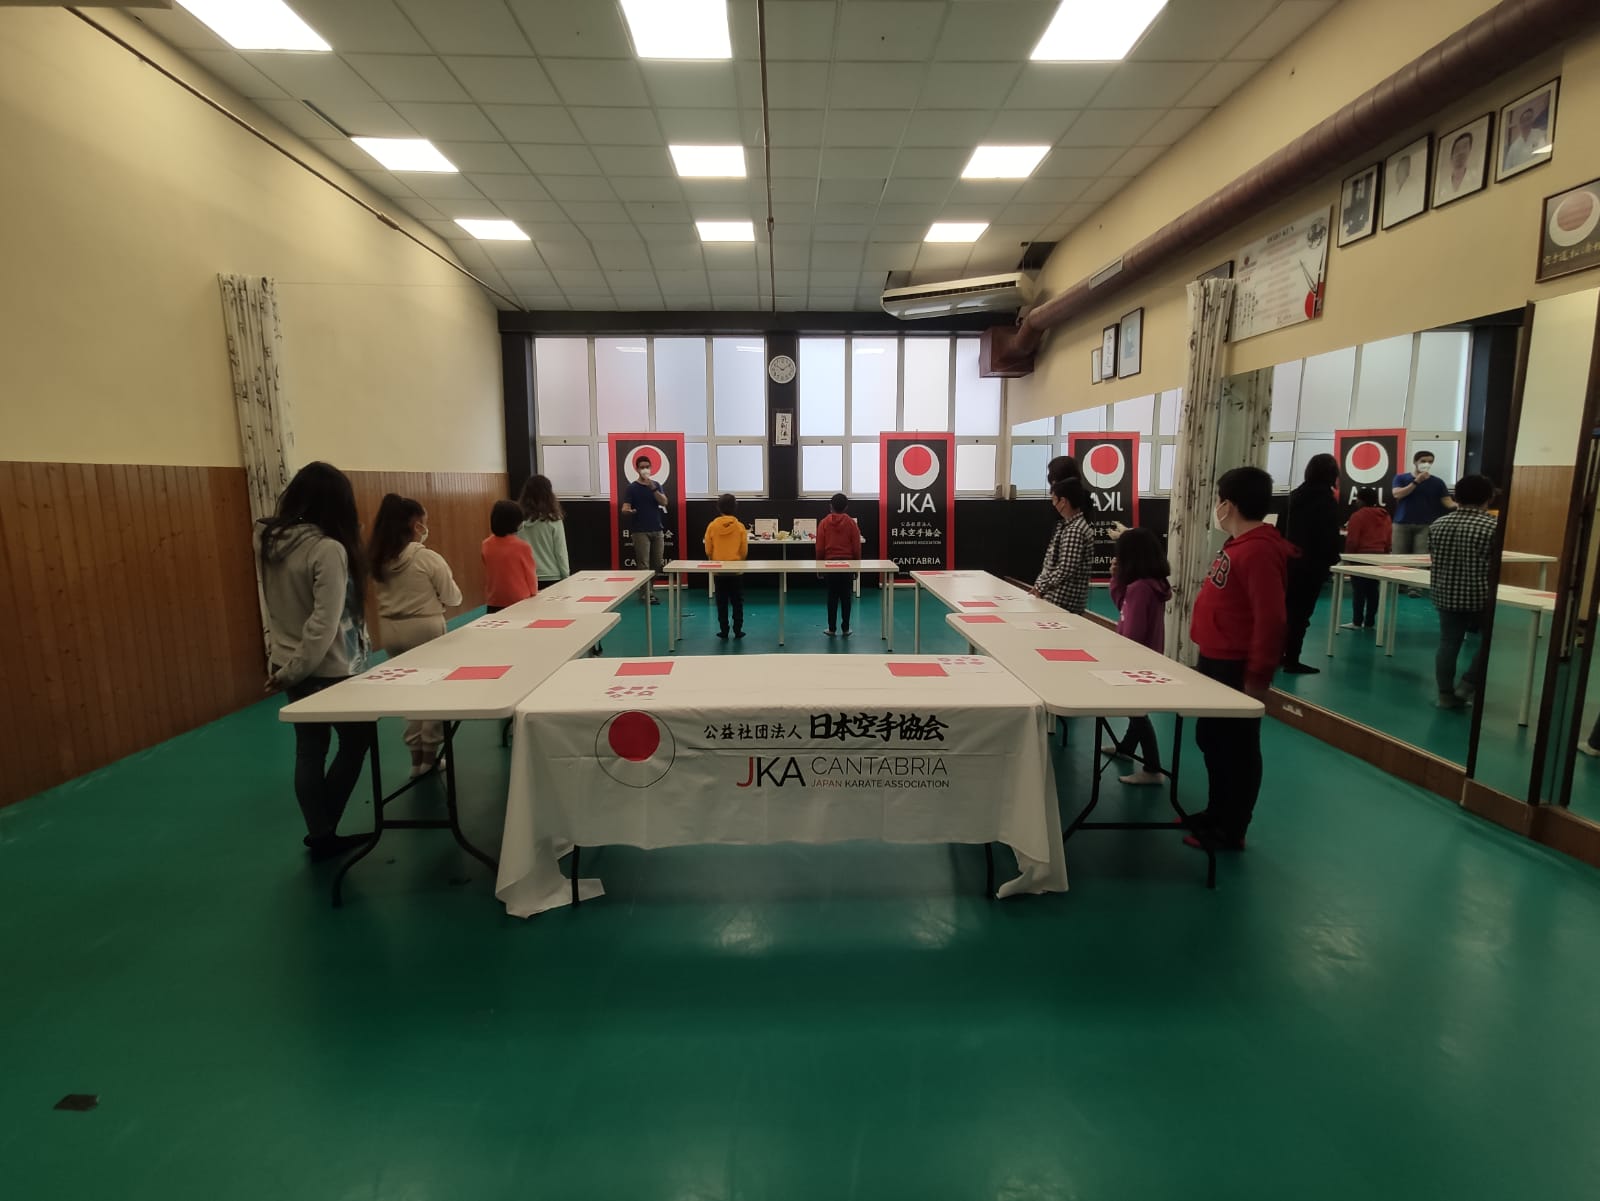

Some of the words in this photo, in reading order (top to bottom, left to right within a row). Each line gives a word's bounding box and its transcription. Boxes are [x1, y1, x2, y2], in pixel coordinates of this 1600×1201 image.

[897, 492, 937, 513] JKA
[893, 557, 942, 565] CANTABRIA
[703, 722, 803, 740] 公益社団法人
[810, 711, 950, 742] 日本空手協会
[736, 756, 807, 787] JKA
[811, 756, 948, 776] CANTABRIA
[811, 779, 842, 788] JAPAN
[844, 779, 881, 788] KARATE
[884, 779, 950, 788] ASSOCIATION
